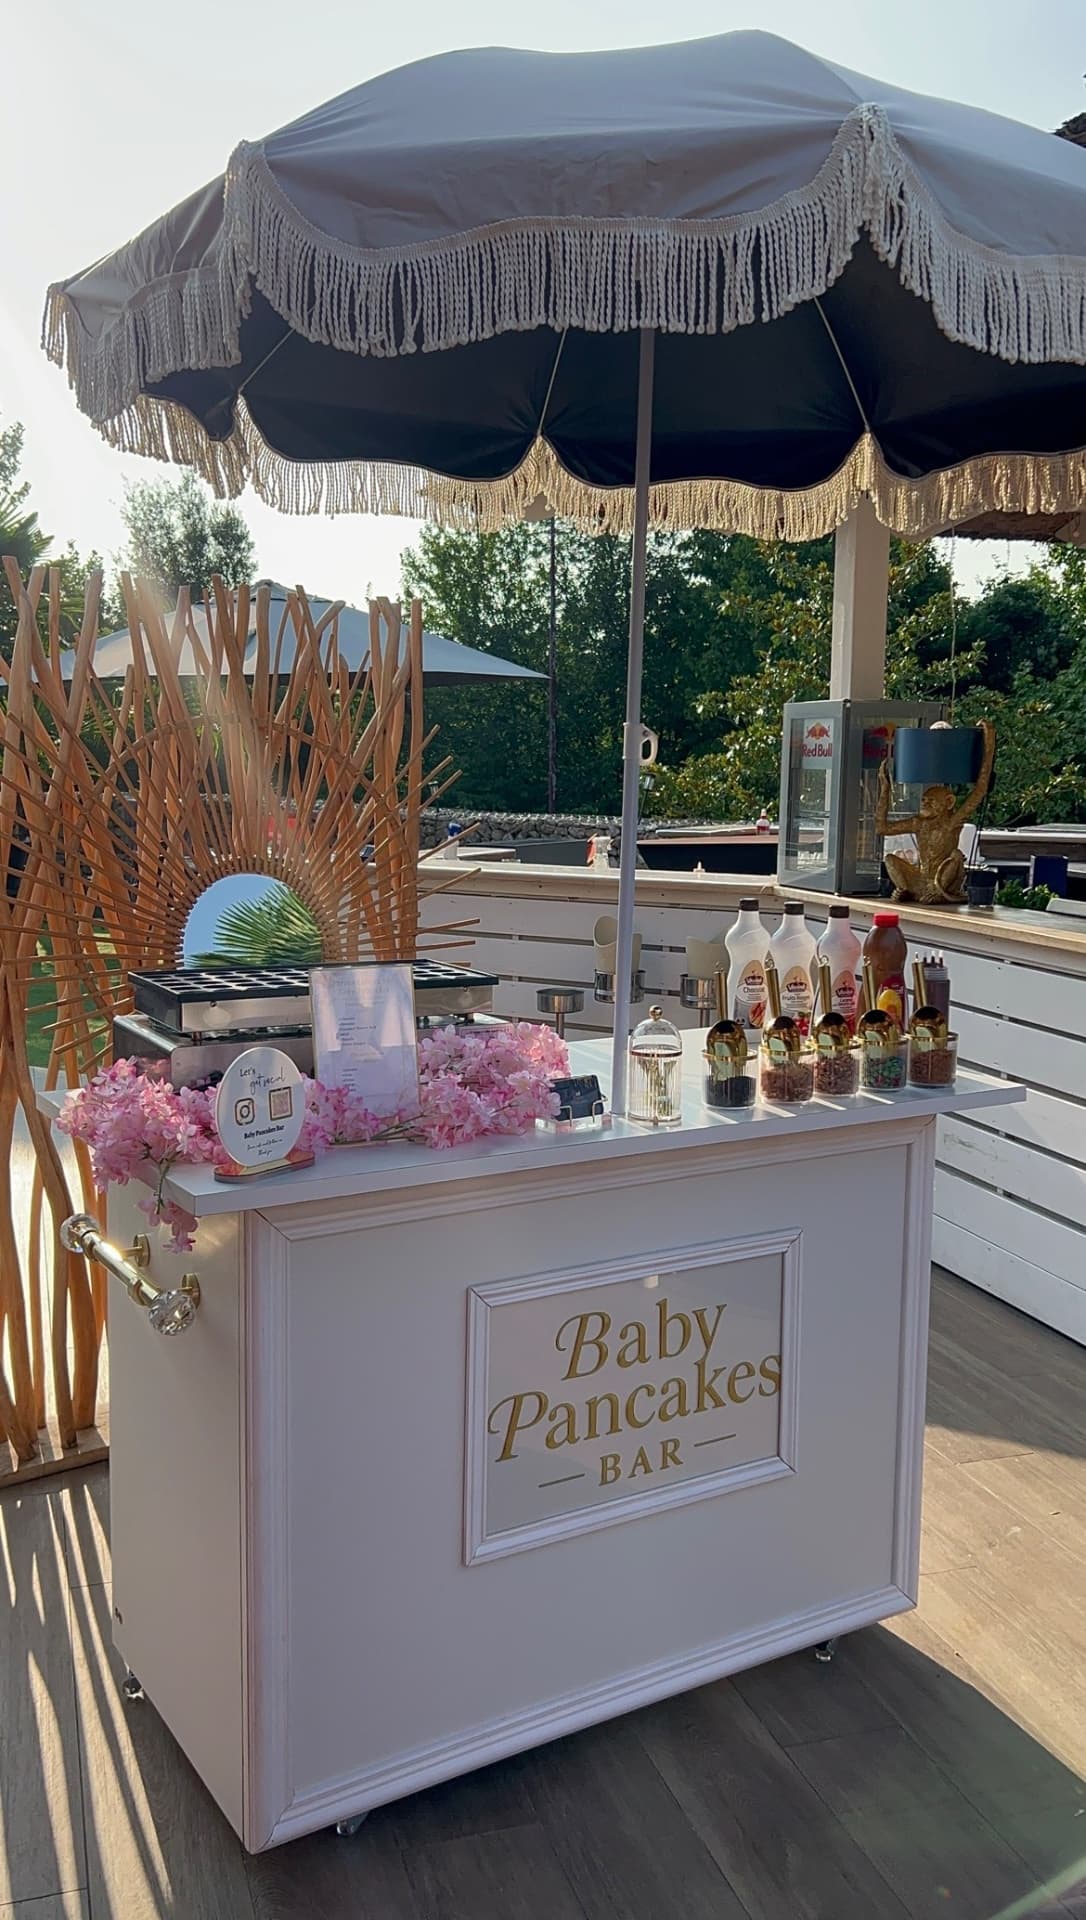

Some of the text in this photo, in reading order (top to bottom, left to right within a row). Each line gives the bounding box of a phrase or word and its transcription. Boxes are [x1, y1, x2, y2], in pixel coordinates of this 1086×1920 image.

[801, 743, 833, 757] Red Bull
[240, 1067, 256, 1078] Let's
[244, 1131, 256, 1140] Baby
[555, 1298, 728, 1381] Baby
[487, 1354, 782, 1463] Pancakes
[598, 1437, 684, 1487] BAR
